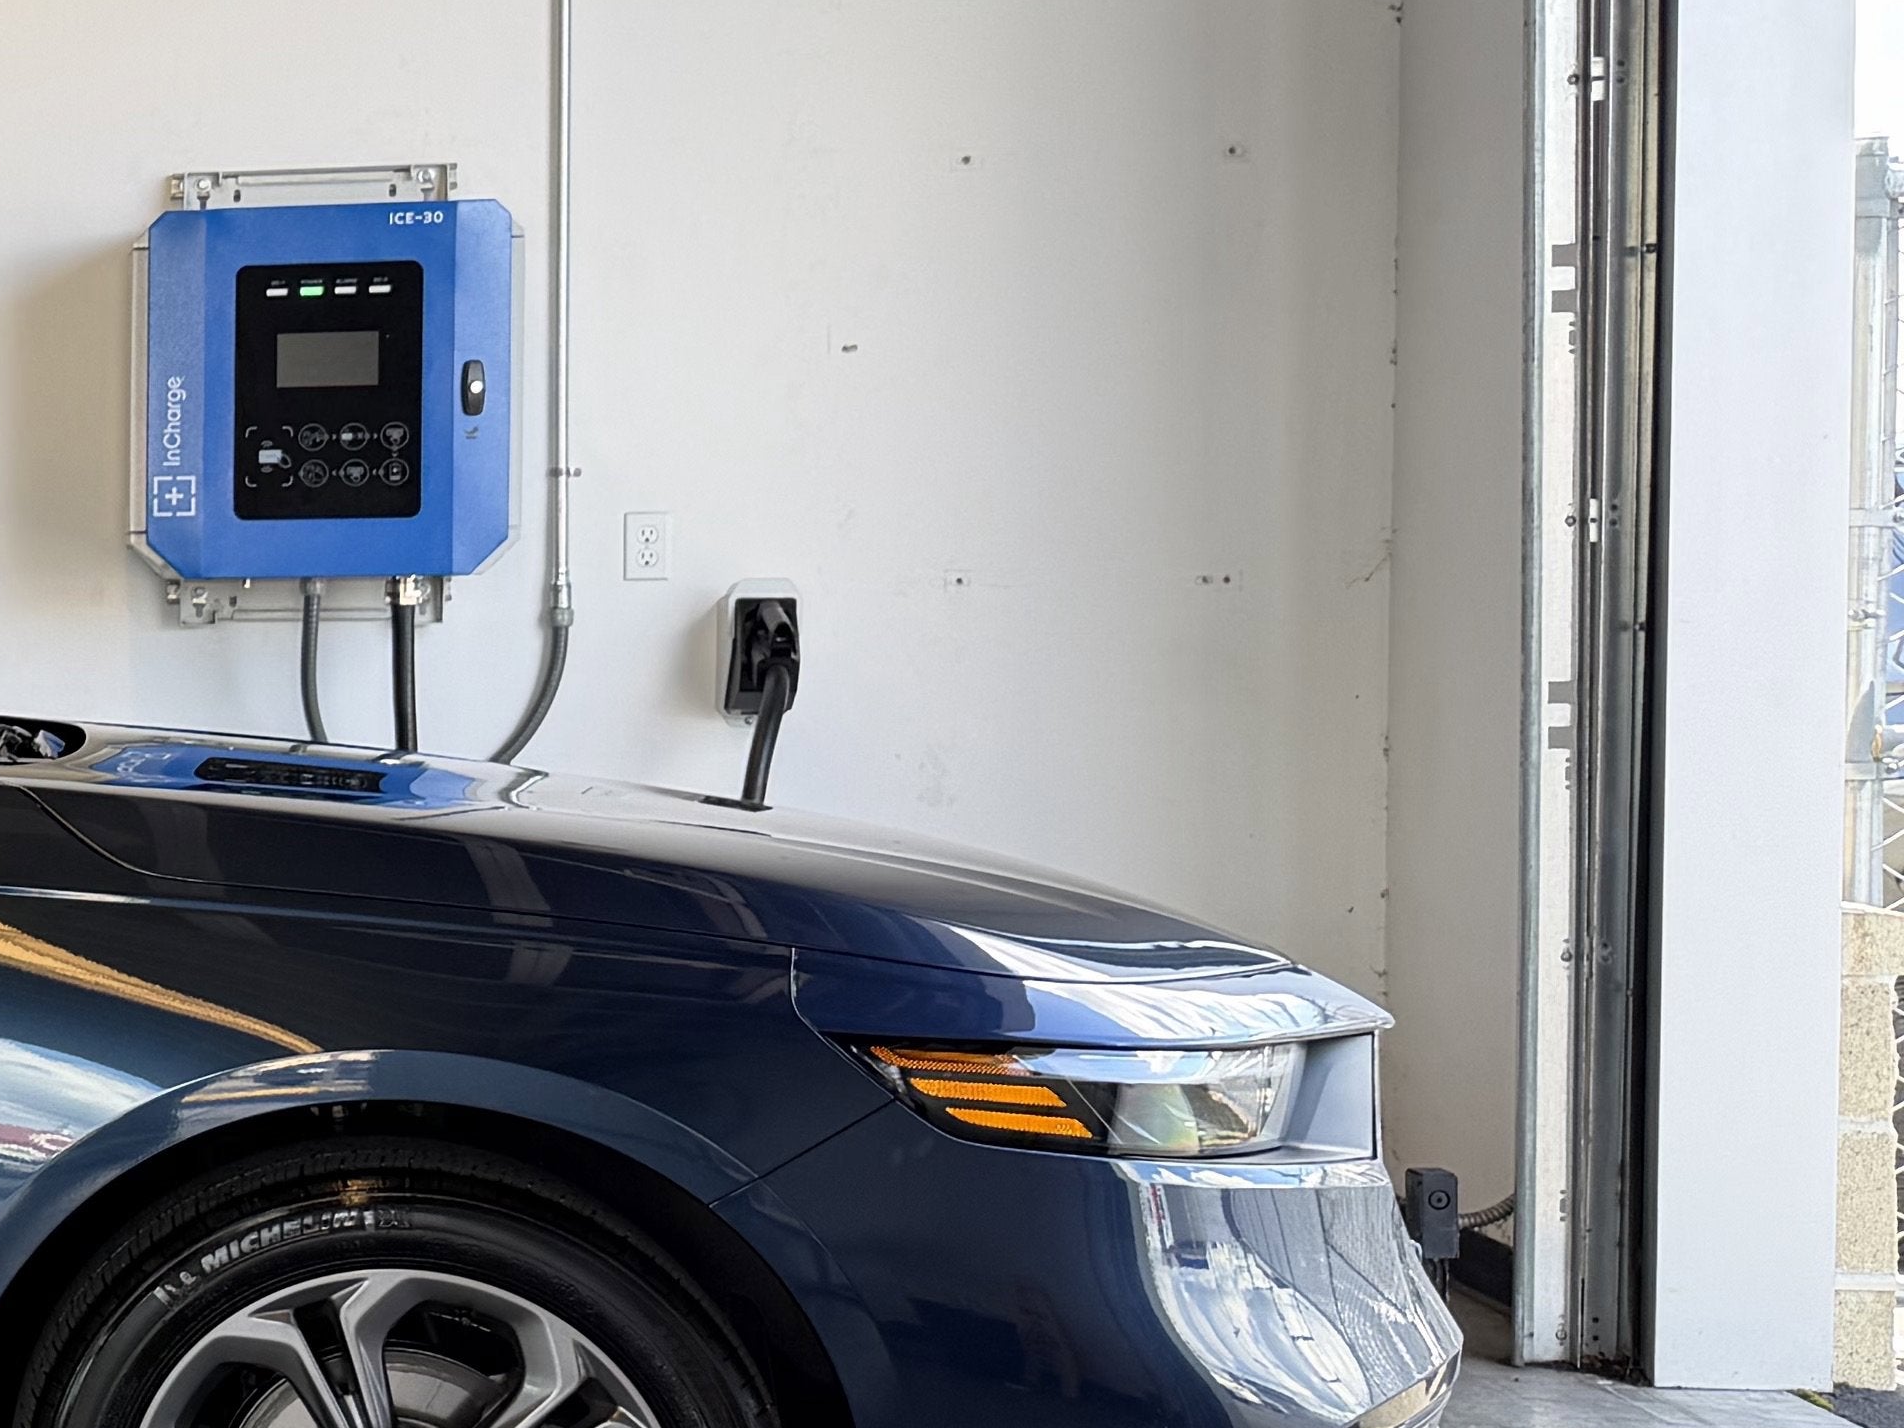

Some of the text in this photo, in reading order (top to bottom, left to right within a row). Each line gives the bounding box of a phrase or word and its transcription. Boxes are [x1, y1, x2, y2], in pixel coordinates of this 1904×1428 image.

[389, 211, 444, 225] ICE-30
[162, 375, 186, 466] InCharge
[200, 1210, 358, 1274] MICHELIN
